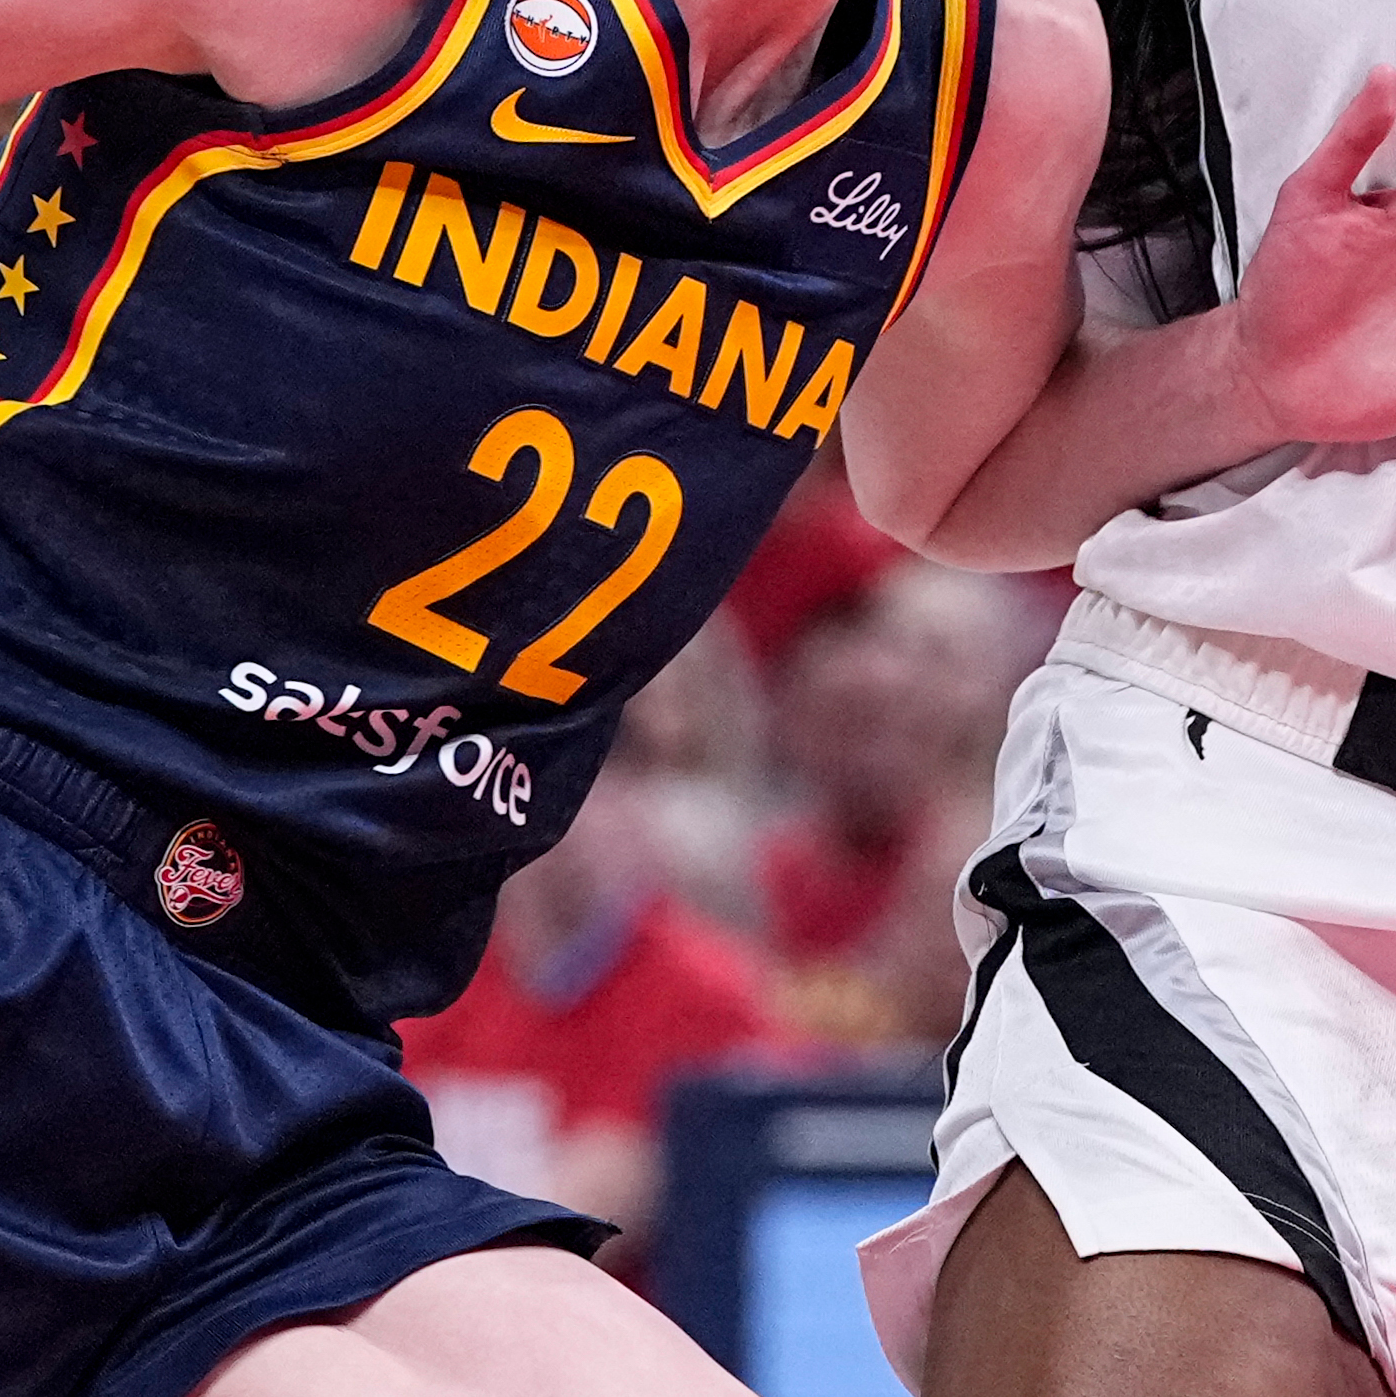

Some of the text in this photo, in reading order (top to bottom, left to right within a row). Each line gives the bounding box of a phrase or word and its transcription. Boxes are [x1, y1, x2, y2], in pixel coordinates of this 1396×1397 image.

[350, 161, 856, 450] INDIANA
[809, 170, 909, 261] Lilly
[367, 407, 684, 706] 22
[159, 844, 242, 904] Fever
